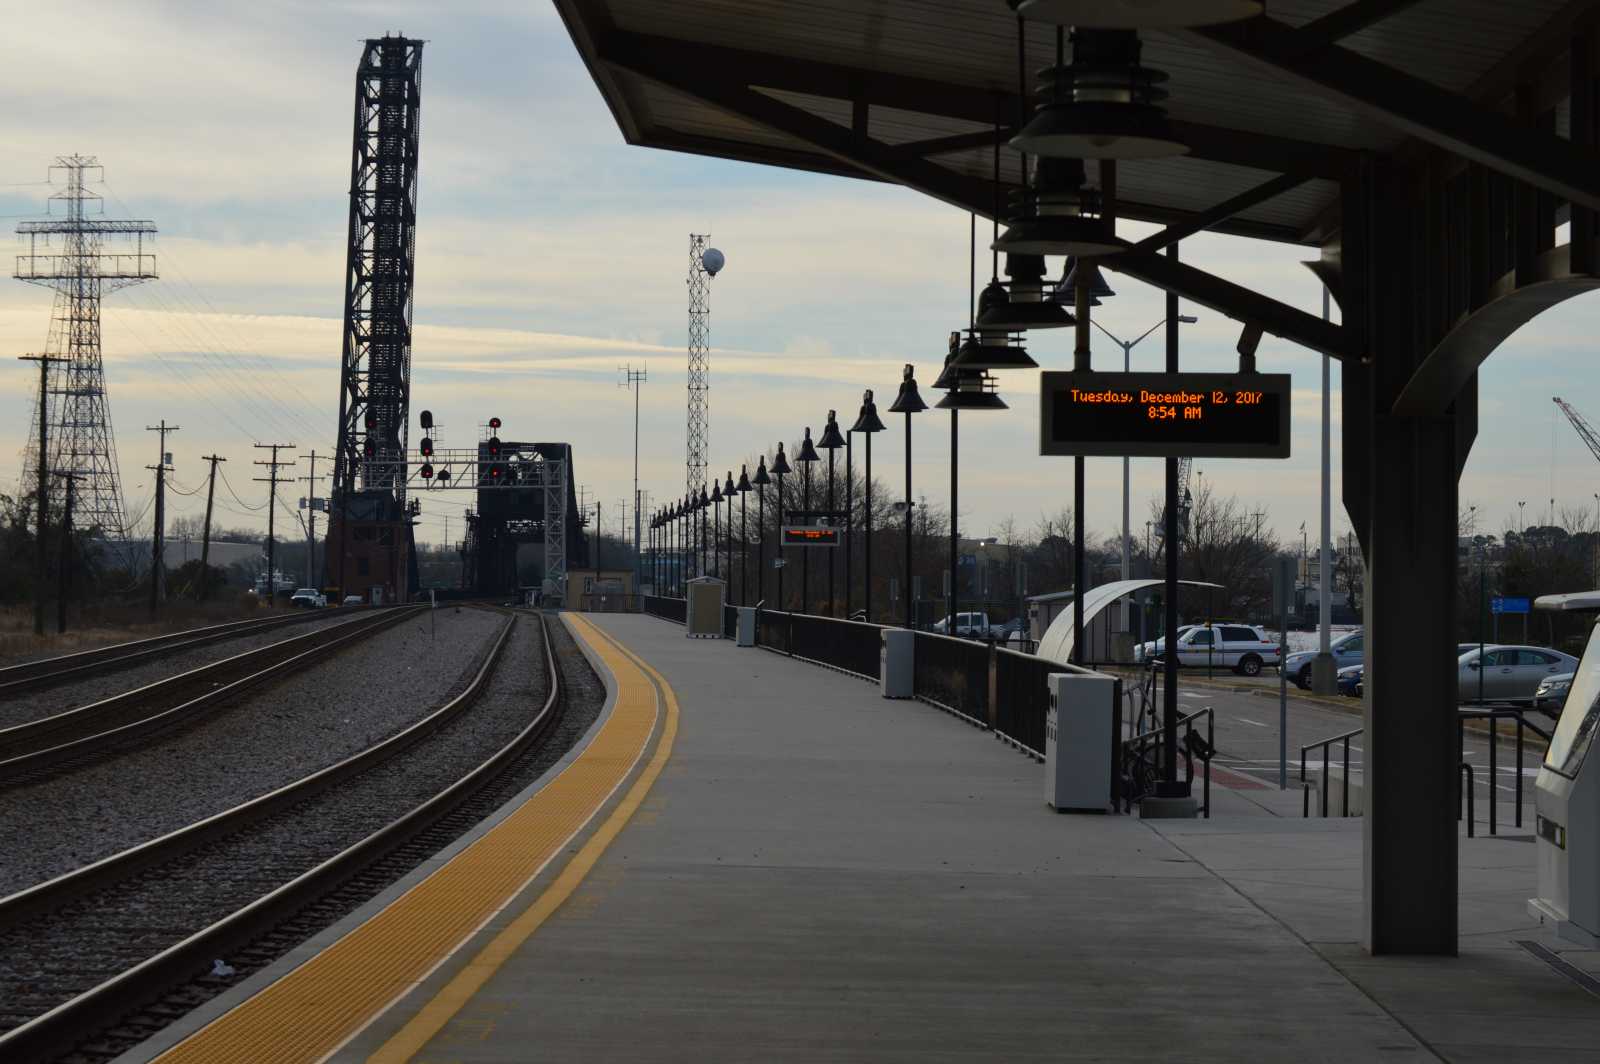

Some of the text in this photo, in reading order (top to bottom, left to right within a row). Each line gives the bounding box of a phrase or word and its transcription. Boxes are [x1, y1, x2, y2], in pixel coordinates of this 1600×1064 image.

[1071, 389, 1133, 403] Tuesday,
[1140, 390, 1204, 404] December
[1235, 391, 1262, 404] 2017
[1148, 406, 1201, 419] 8:54 AM
